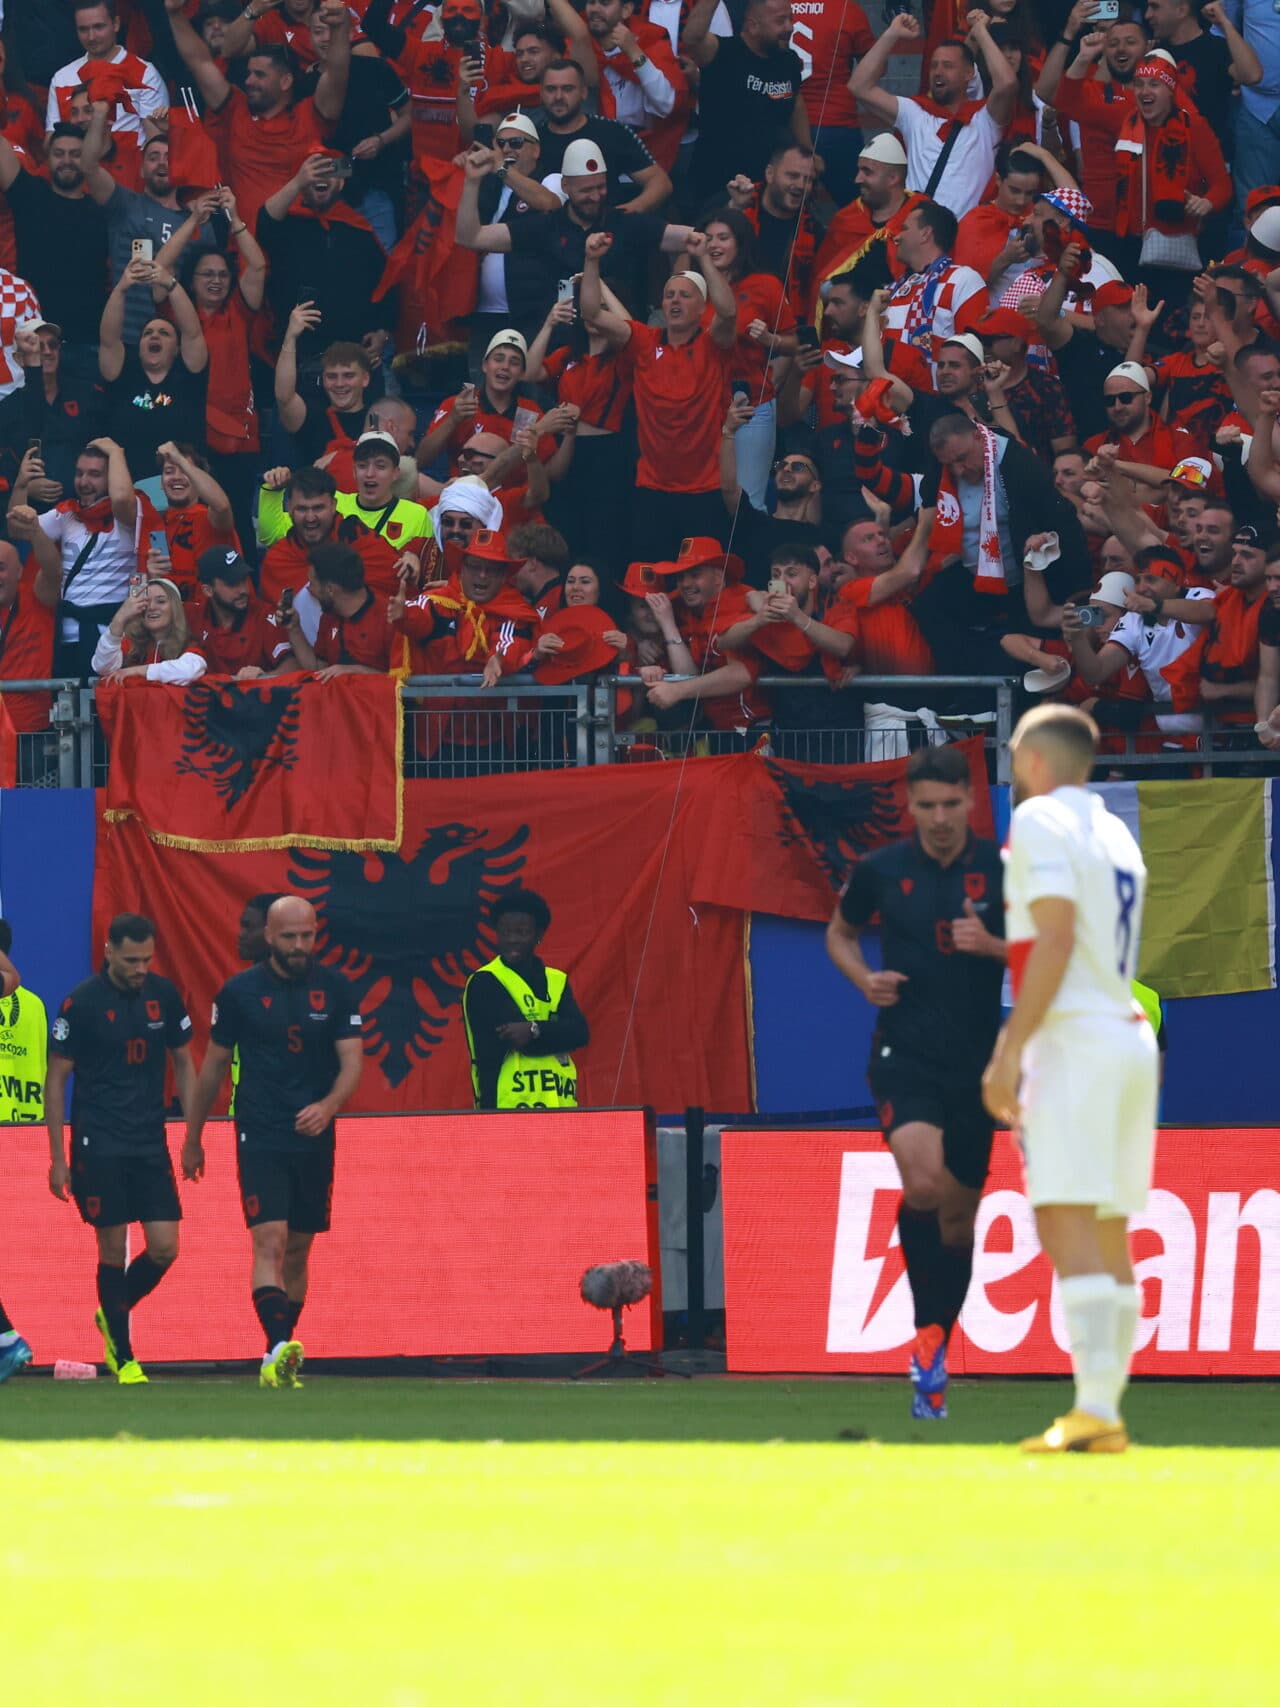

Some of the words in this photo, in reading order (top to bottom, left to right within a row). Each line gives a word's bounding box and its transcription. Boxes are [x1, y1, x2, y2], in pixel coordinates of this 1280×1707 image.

[161, 222, 173, 245] 5
[1114, 867, 1137, 980] 8
[127, 1037, 147, 1065] 10
[825, 1151, 1280, 1353] Bean
